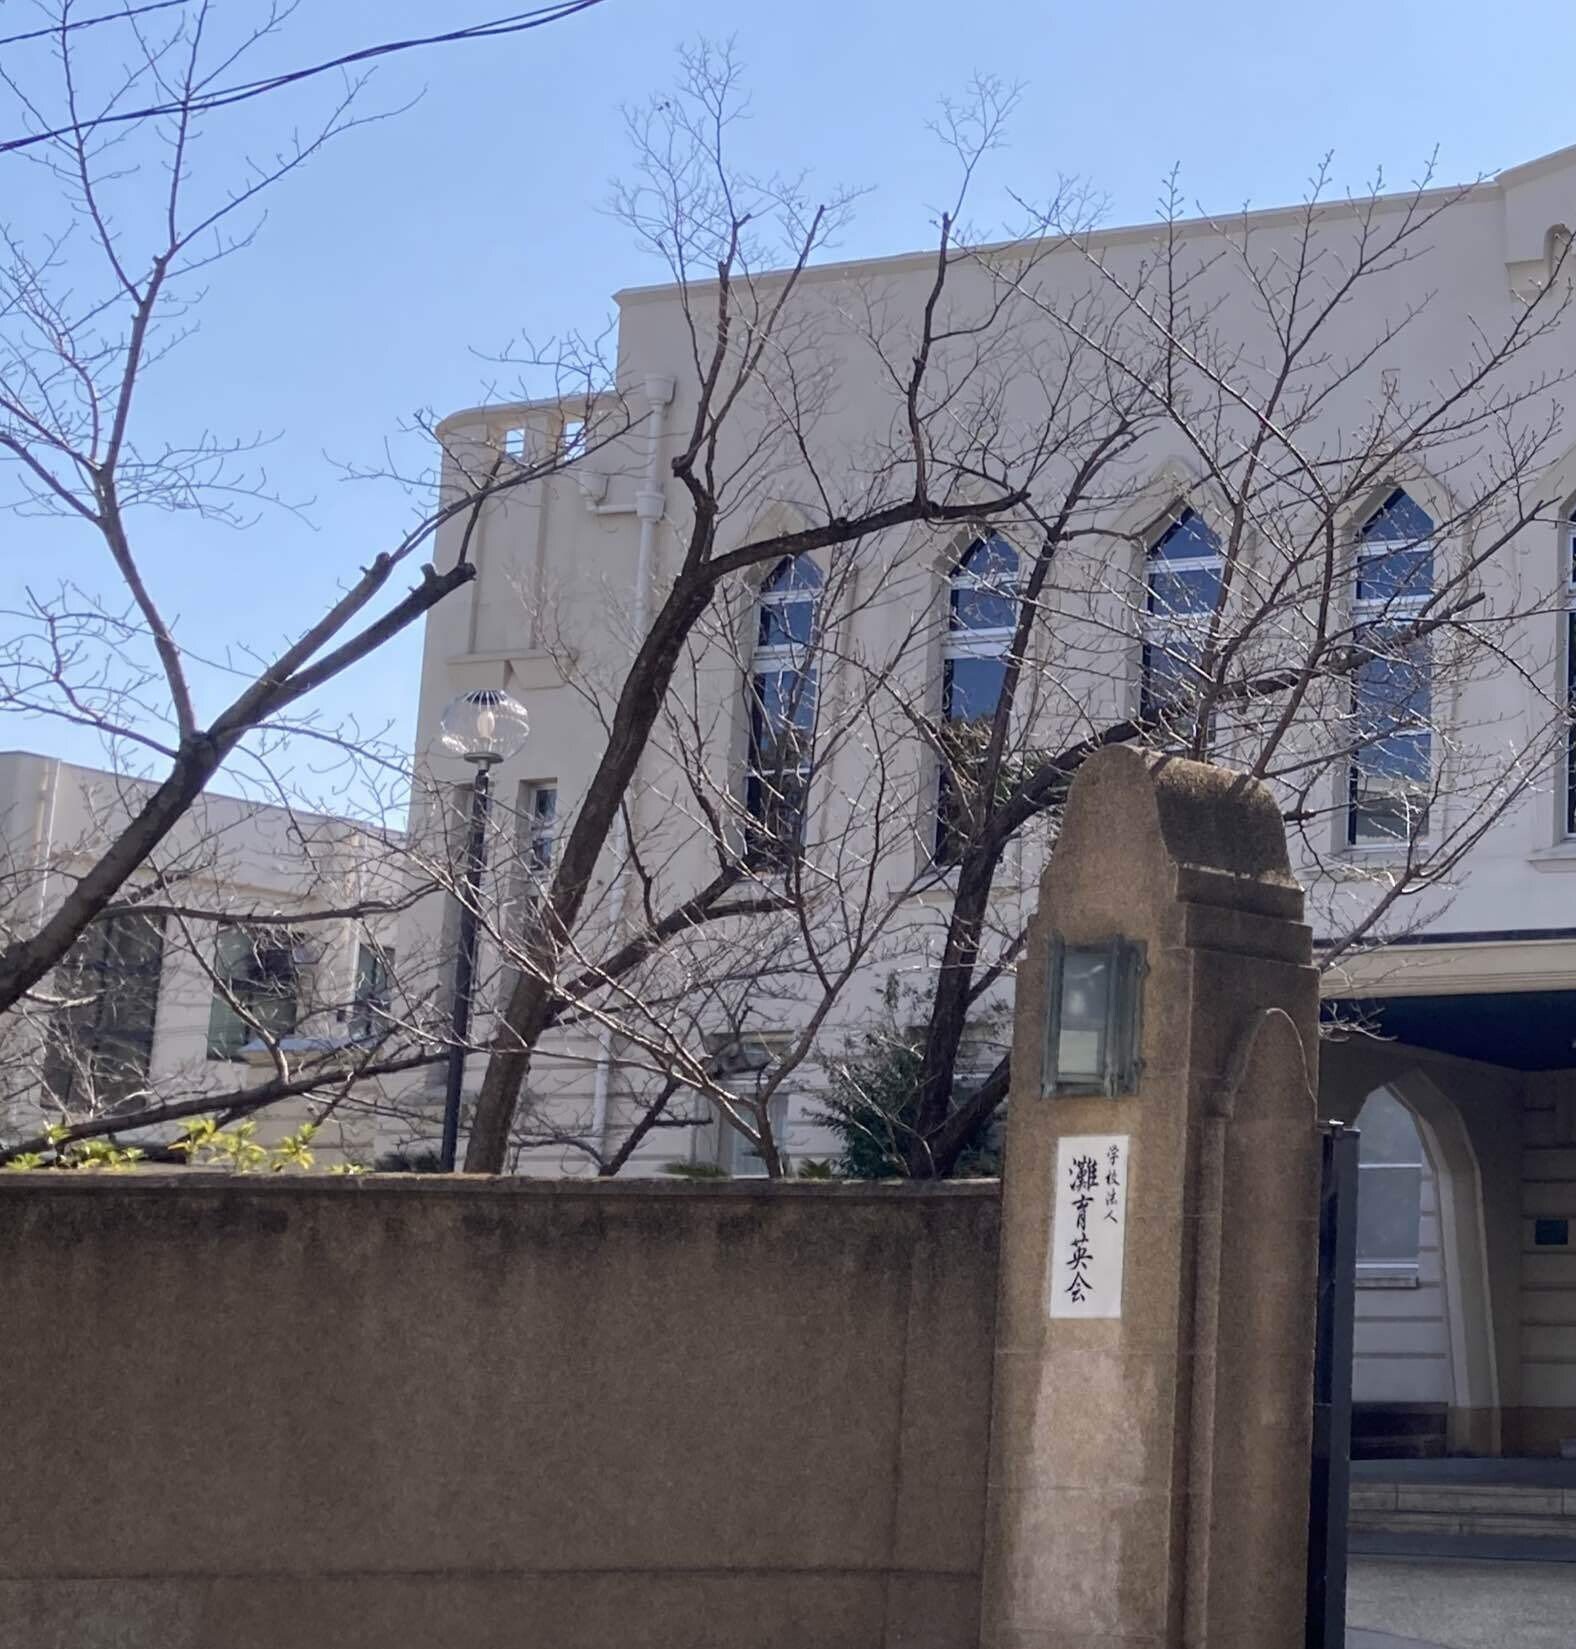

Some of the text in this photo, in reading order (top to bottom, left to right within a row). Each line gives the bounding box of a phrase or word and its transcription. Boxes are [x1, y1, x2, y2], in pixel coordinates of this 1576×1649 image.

[1065, 1155, 1099, 1302] 灘育英会
[1104, 1145, 1120, 1224] 学校法人
